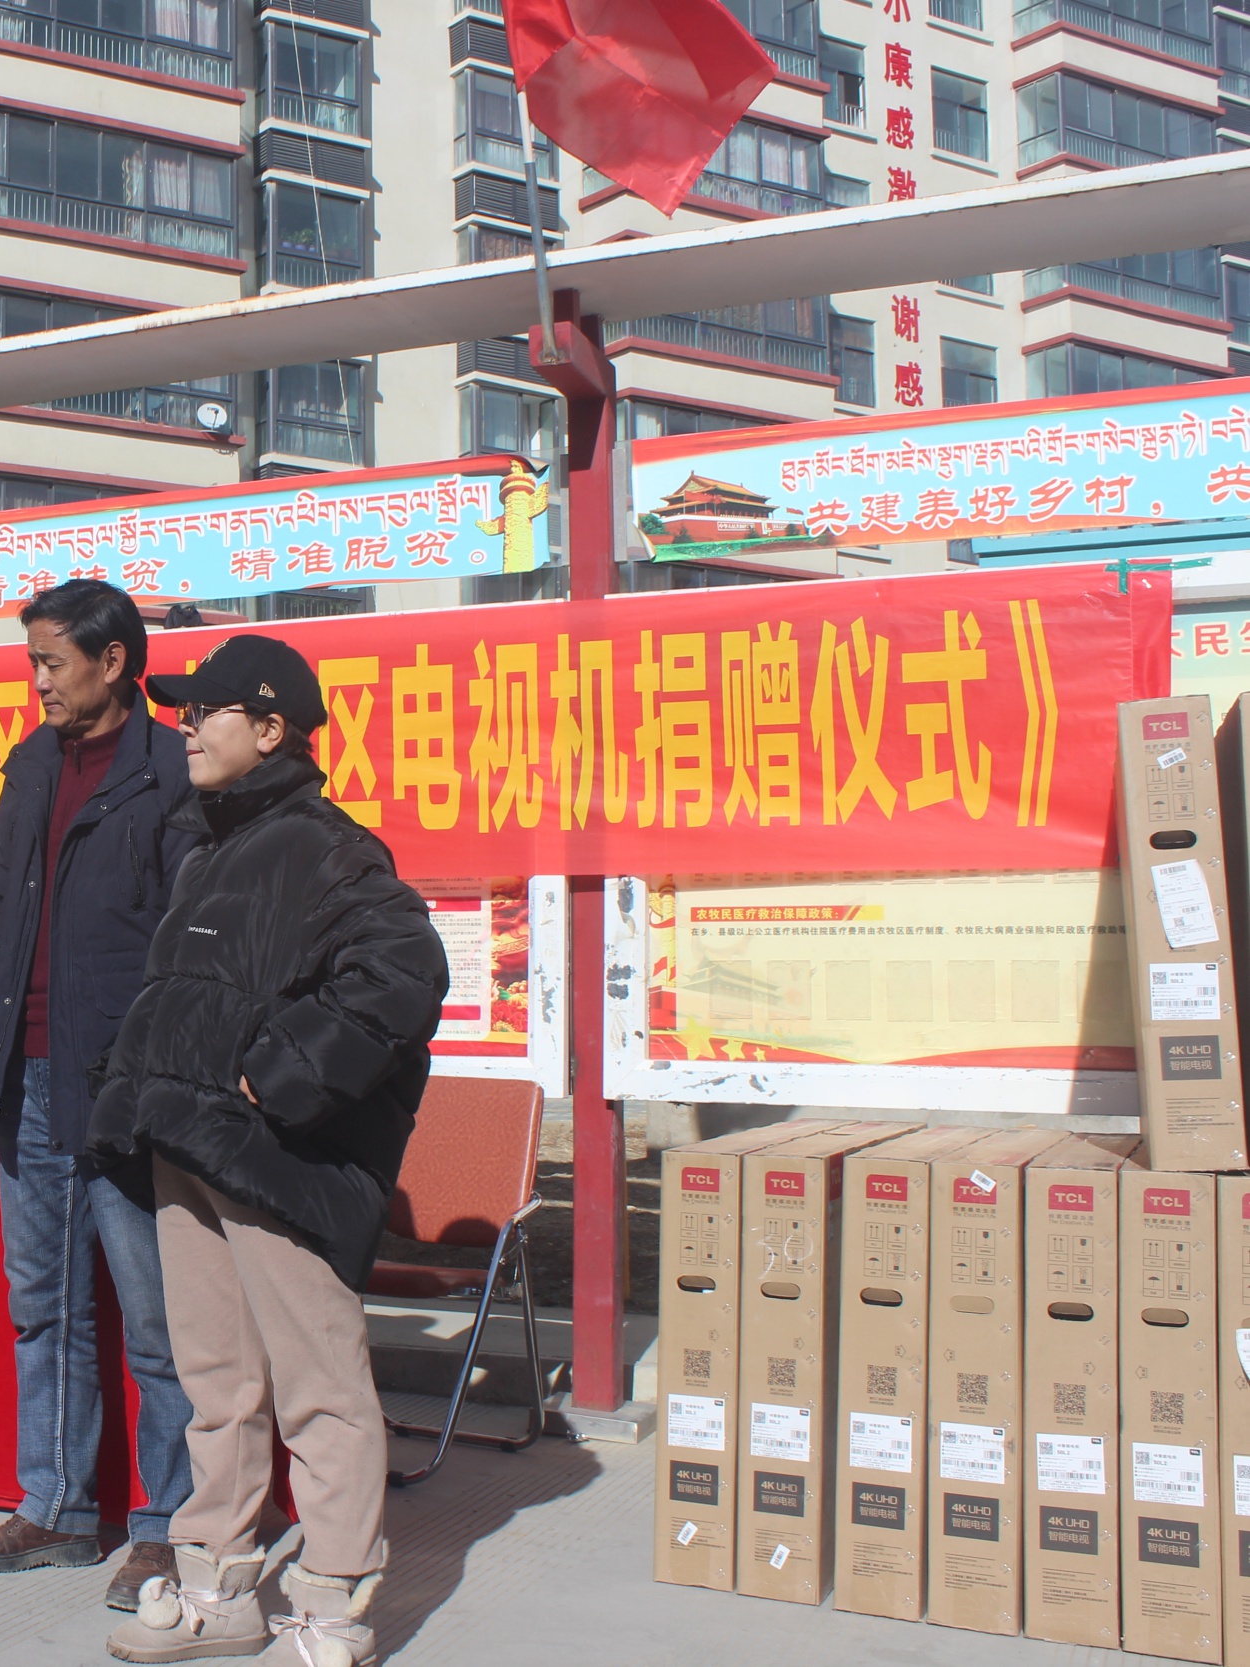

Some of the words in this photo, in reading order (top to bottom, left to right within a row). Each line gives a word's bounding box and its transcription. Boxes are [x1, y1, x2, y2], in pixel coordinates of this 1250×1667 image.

[1148, 720, 1183, 732] TCL
[1169, 1046, 1185, 1055] 4K
[1187, 1045, 1211, 1055] UHD
[1169, 1059, 1212, 1070] 智能电视
[687, 1174, 715, 1186] TCL
[770, 1178, 799, 1190] TCL
[872, 1181, 902, 1194] TCL
[1055, 1193, 1087, 1204] TCL
[1150, 1196, 1184, 1208] TCL
[676, 1470, 691, 1479] 4K
[691, 1471, 712, 1482] UHD
[676, 1483, 711, 1496] 智能电视
[760, 1481, 775, 1490] 4K
[776, 1482, 798, 1493] UHD
[760, 1494, 797, 1508] 智能电视
[859, 1492, 874, 1502] 4K
[875, 1494, 898, 1505] UHD
[859, 1506, 897, 1520] 智能电视
[951, 1503, 966, 1513] 4K
[968, 1505, 991, 1516] UHD
[951, 1517, 991, 1531] 智能电视
[1048, 1516, 1063, 1526] 4K
[1065, 1517, 1090, 1529] UHD
[1048, 1531, 1090, 1545] 智能电视
[1147, 1527, 1163, 1538] 4K
[1165, 1529, 1191, 1541] UHD
[1147, 1542, 1191, 1557] 智能电视
